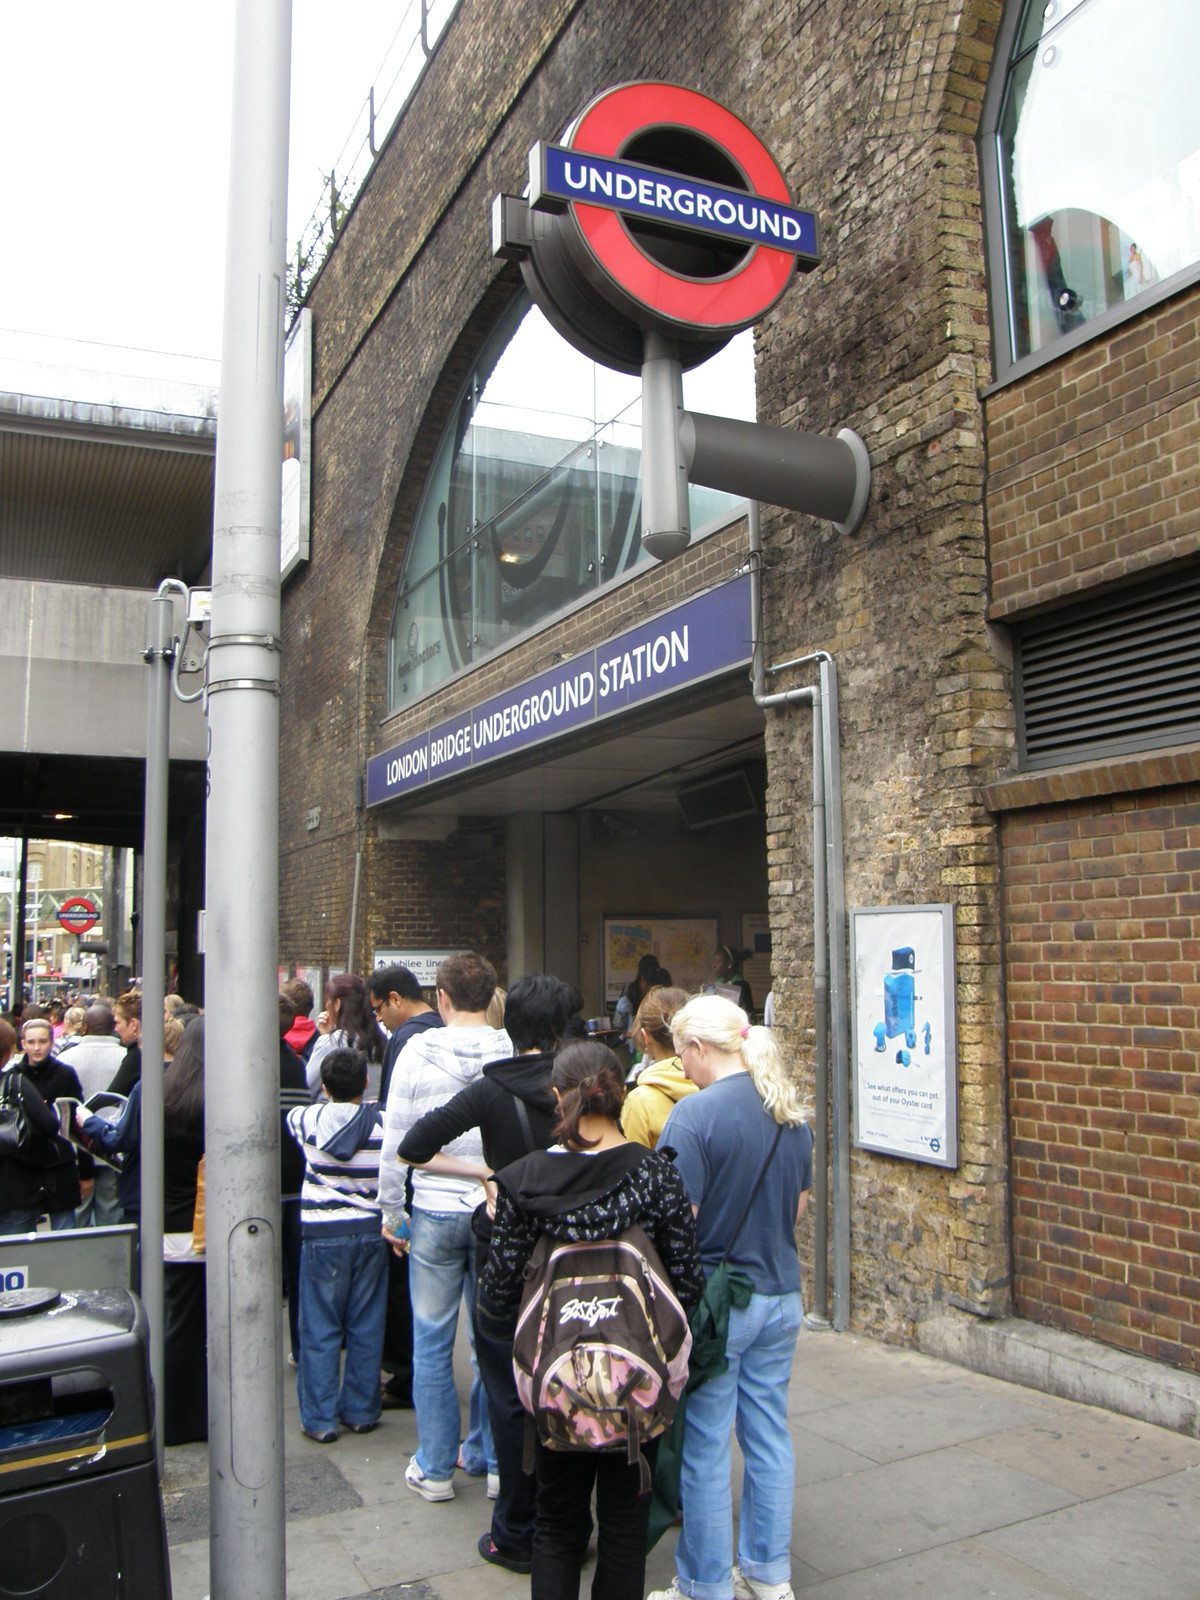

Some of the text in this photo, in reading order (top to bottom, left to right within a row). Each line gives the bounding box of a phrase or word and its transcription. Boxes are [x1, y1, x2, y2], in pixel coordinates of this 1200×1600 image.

[564, 161, 801, 241] UNDERGROUND
[387, 624, 689, 785] LONDON BRIDGE UNDERGROUND STATION
[391, 959, 442, 968] Jubilee line
[867, 1082, 876, 1090] See
[877, 1084, 891, 1092] what
[891, 1086, 907, 1095] offers
[908, 1088, 918, 1097] you
[929, 1092, 938, 1100] get
[889, 1097, 900, 1105] your
[901, 1098, 920, 1107] Oyster
[920, 1101, 932, 1110] card
